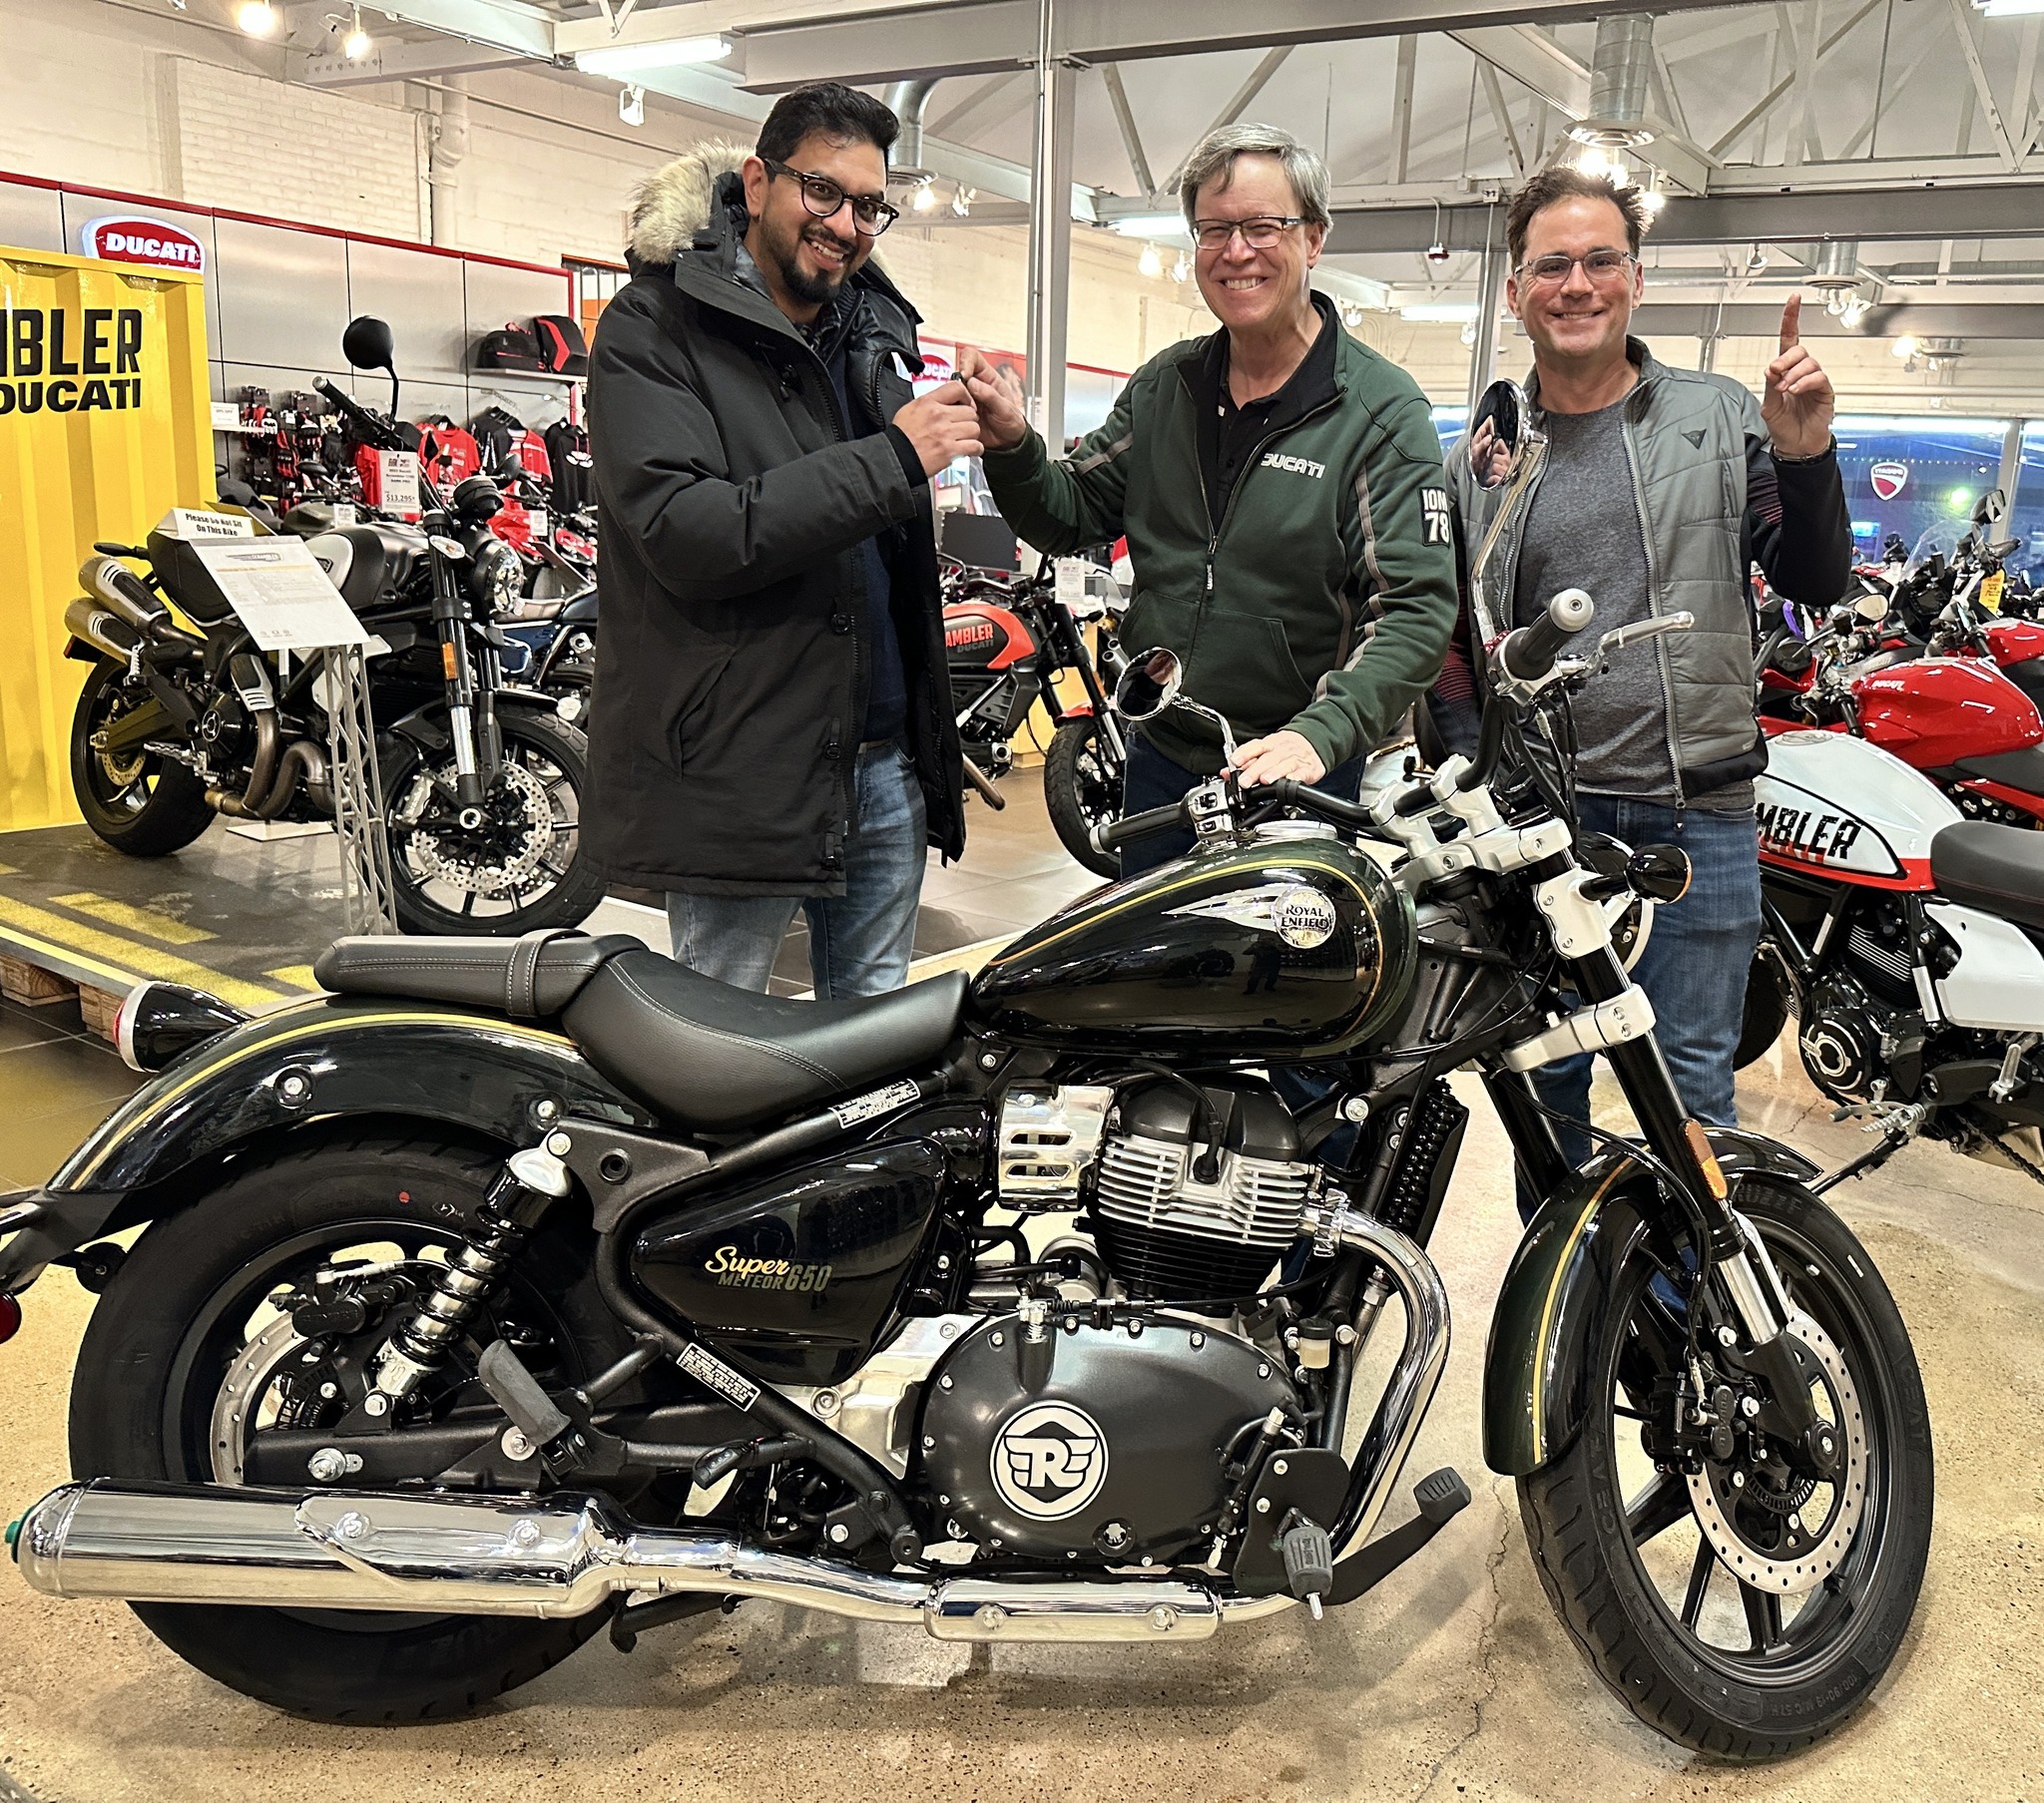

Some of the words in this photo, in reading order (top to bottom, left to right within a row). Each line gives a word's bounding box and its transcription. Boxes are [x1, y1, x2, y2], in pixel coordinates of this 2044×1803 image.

[106, 232, 197, 263] DUCATI
[1261, 453, 1325, 479] DUCATI
[1421, 488, 1448, 513] IOM
[185, 513, 210, 524] Please
[233, 519, 244, 528] Sit
[207, 525, 222, 535] This
[223, 528, 239, 537] Bike
[1424, 512, 1450, 544] 78
[956, 639, 994, 654] DUCATI
[1285, 904, 1325, 917] ROYAL
[1280, 917, 1330, 930] ENFIELD
[705, 1245, 790, 1280] Super
[718, 1272, 784, 1290] METEOR
[784, 1264, 832, 1292] 650
